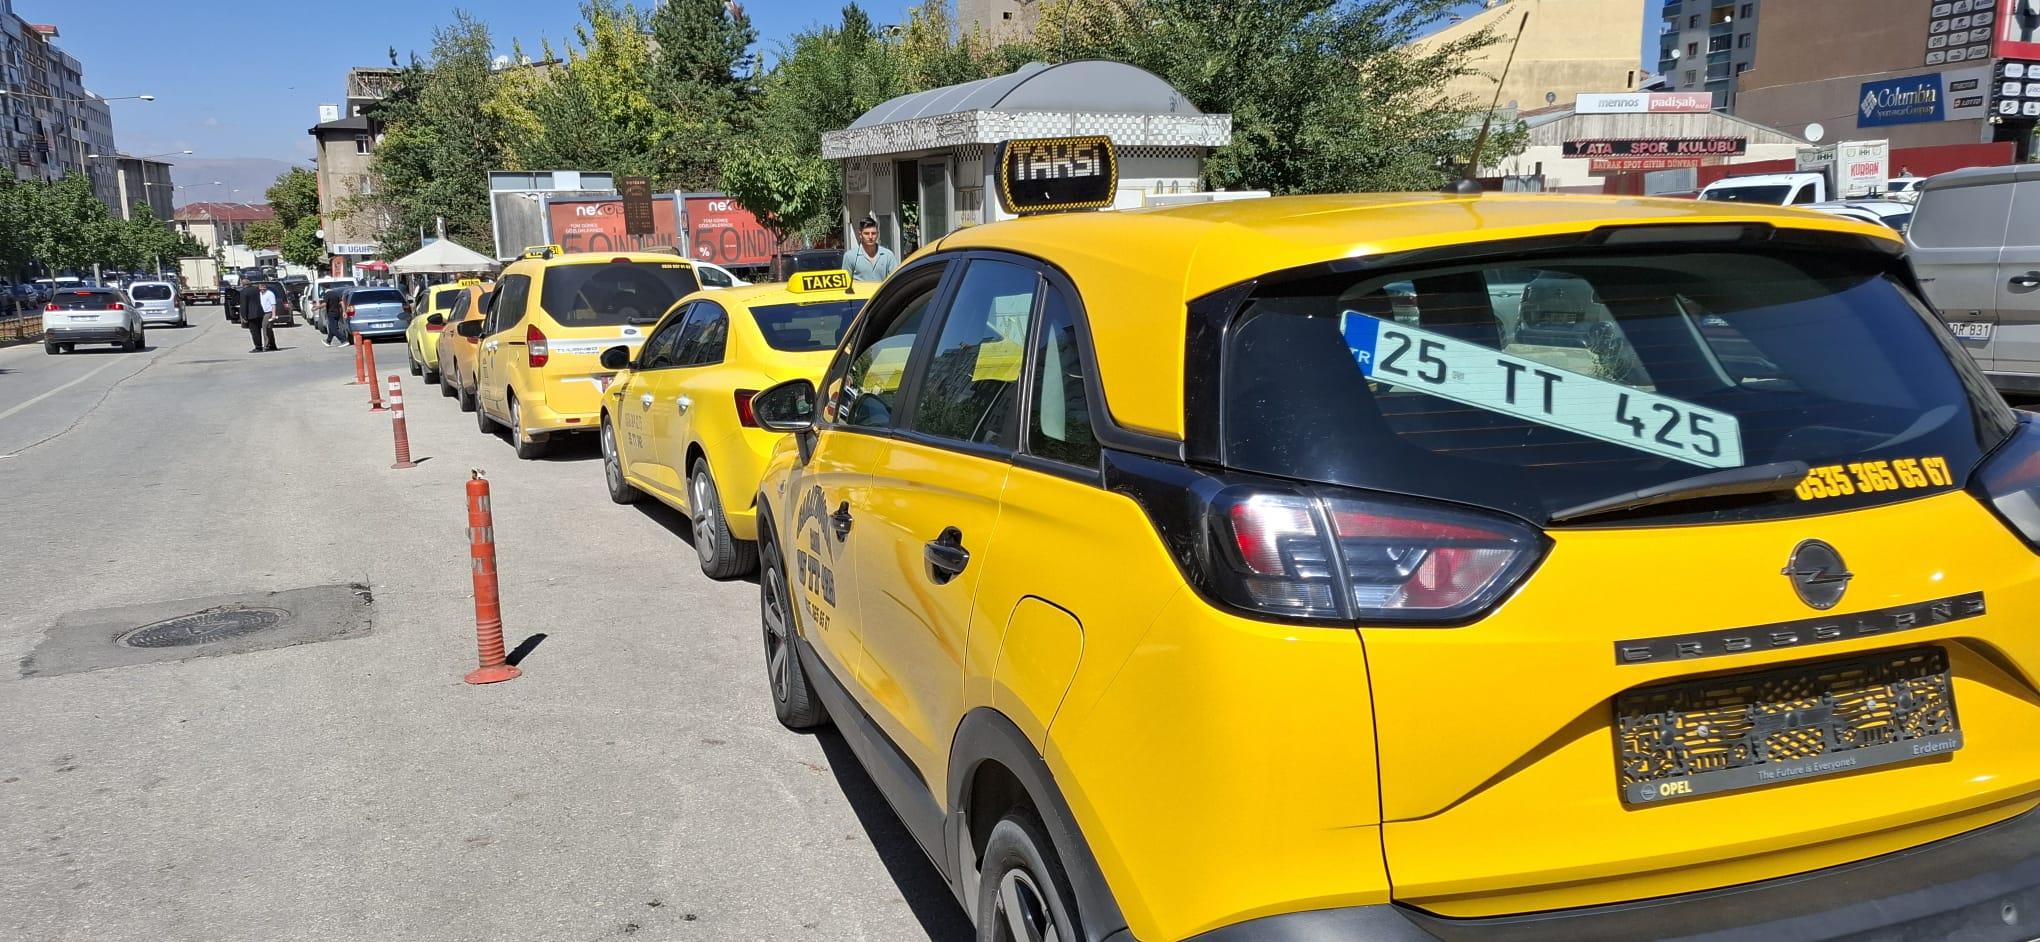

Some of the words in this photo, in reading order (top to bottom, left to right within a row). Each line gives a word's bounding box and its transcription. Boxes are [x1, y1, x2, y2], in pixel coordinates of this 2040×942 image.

[1598, 98, 1640, 108] mennos
[1651, 95, 1697, 110] padişah
[1877, 83, 1937, 108] Columbia
[1587, 142, 1613, 154] ATA
[1630, 142, 1668, 154] SPOR
[1677, 138, 1738, 153] KULÜBÜ
[1623, 160, 1642, 168] SPOT
[1850, 161, 1880, 177] KURBAN
[694, 226, 742, 263] 50
[1969, 324, 1989, 336] 831
[1379, 330, 1447, 385] 25
[1497, 359, 1562, 415] TT
[1615, 393, 1721, 458] 425
[1847, 460, 1899, 493] 365
[1892, 458, 1928, 489] 65
[1920, 456, 1953, 486] 67
[1912, 738, 1957, 756] Erdemir
[1757, 770, 1775, 781] The
[1776, 766, 1803, 779] Future
[1805, 765, 1812, 774] is
[1813, 758, 1857, 773] Everyone's
[1659, 780, 1693, 797] OPEL
